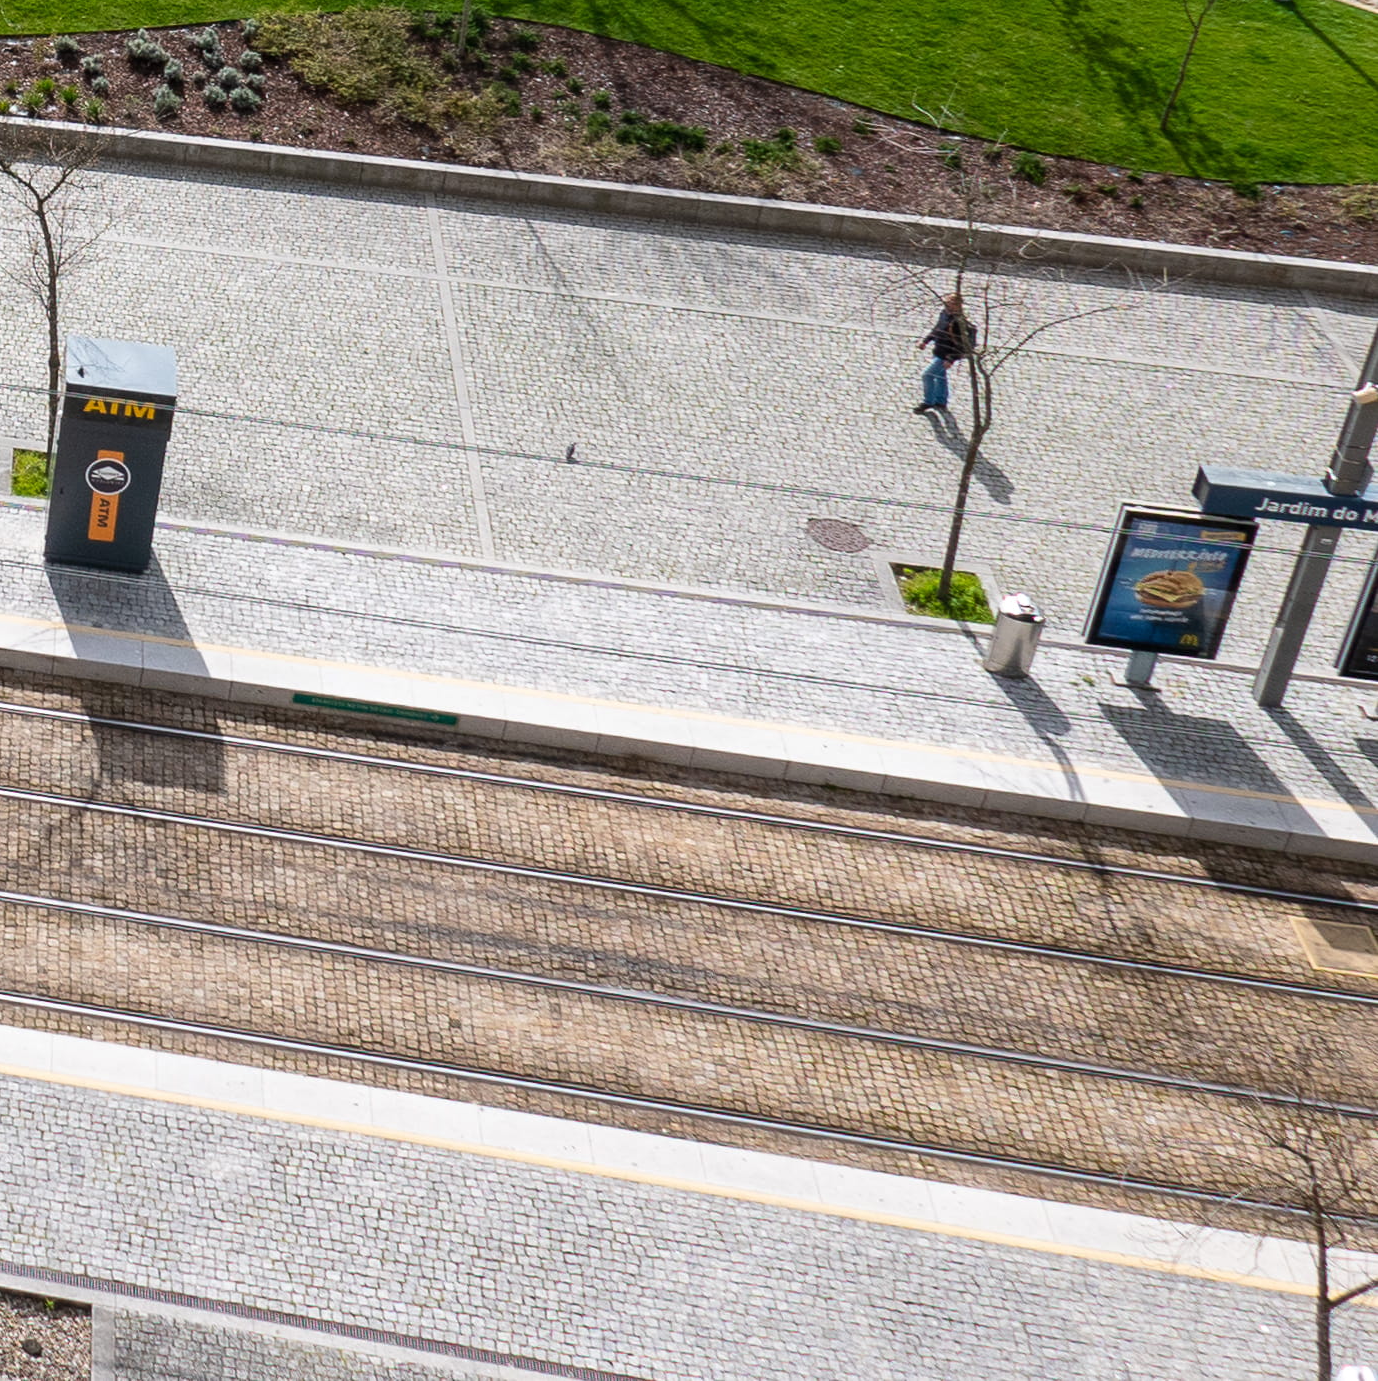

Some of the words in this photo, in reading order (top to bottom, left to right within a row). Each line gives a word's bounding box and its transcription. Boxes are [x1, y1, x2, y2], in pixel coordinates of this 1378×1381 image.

[84, 397, 156, 420] ATM
[98, 498, 110, 528] ATM
[1254, 496, 1327, 518] Jardim
[1332, 506, 1360, 521] do
